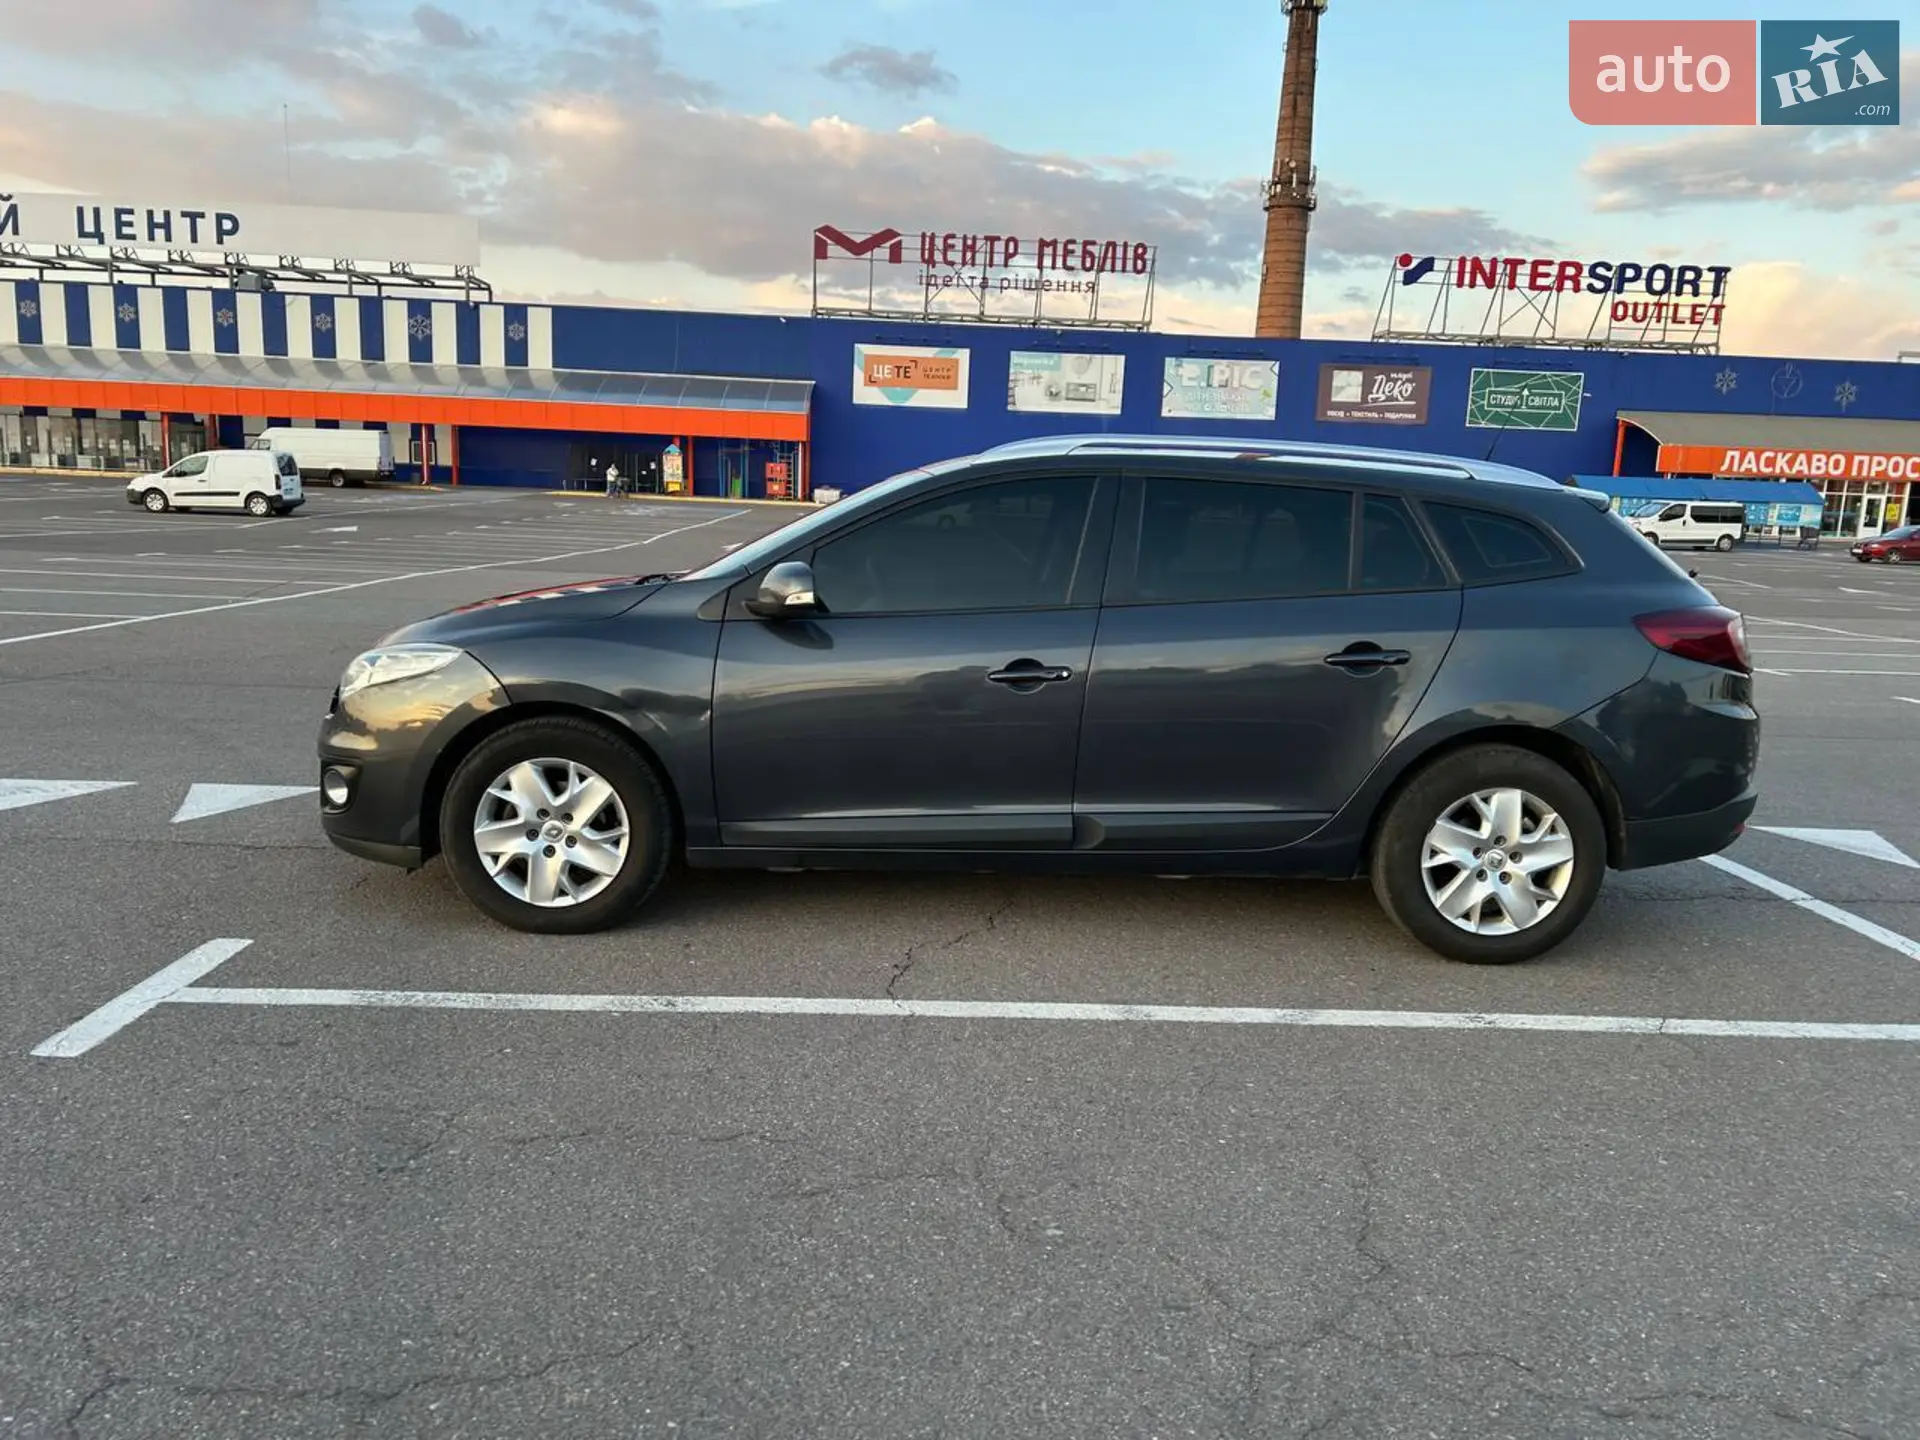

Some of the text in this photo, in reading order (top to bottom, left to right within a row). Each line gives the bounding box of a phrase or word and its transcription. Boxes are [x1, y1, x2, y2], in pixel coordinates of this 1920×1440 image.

[76, 205, 240, 245] ЦЕНТР
[920, 231, 1148, 275] ЦЕНТР МЕБЛІВ
[1000, 272, 1097, 294] рішення
[1456, 256, 1732, 298] INTERSPORT
[1611, 300, 1725, 327] OUTLET
[1527, 395, 1559, 408] СВІТЛА
[1720, 450, 1920, 479] ЛАСКАВО ПРОС
